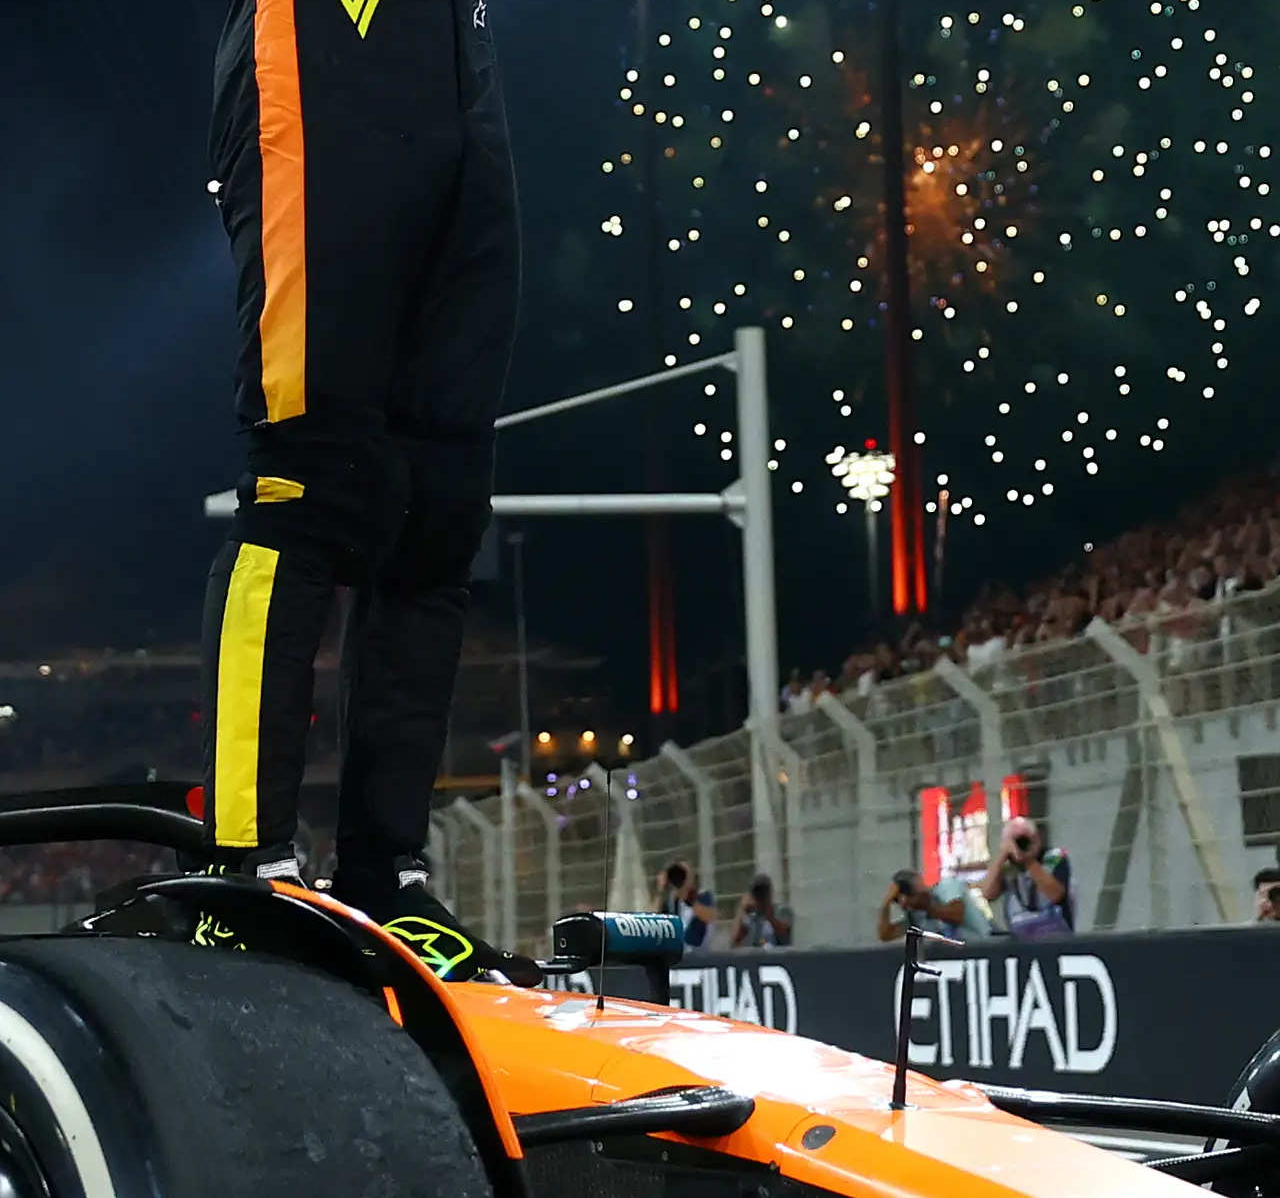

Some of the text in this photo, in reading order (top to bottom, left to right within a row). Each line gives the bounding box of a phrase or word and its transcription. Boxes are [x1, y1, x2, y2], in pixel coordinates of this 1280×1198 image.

[615, 914, 676, 945] allwyn
[670, 965, 797, 1036] TIHAD
[894, 954, 1117, 1073] ETIHAD
